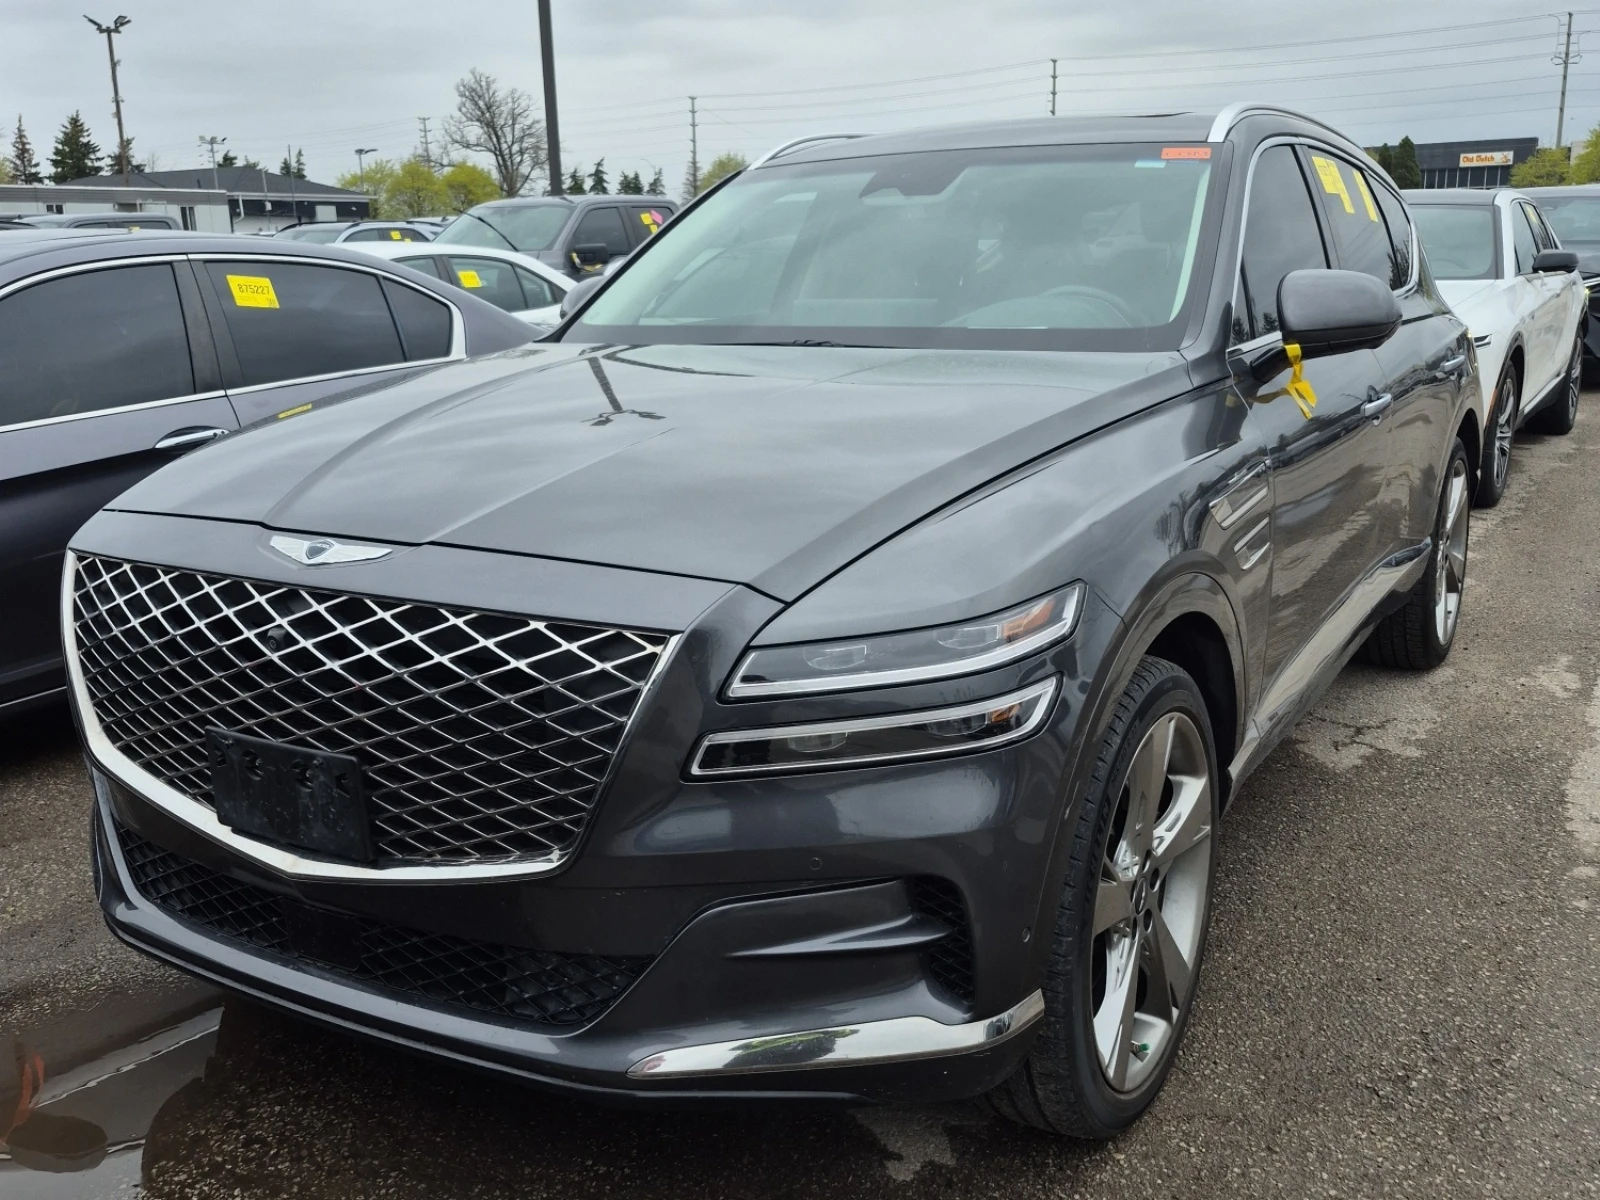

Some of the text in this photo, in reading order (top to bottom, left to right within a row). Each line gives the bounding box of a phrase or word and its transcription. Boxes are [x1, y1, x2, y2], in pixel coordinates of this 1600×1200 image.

[1462, 154, 1495, 163] Old Dutch
[237, 283, 270, 295] 875227
